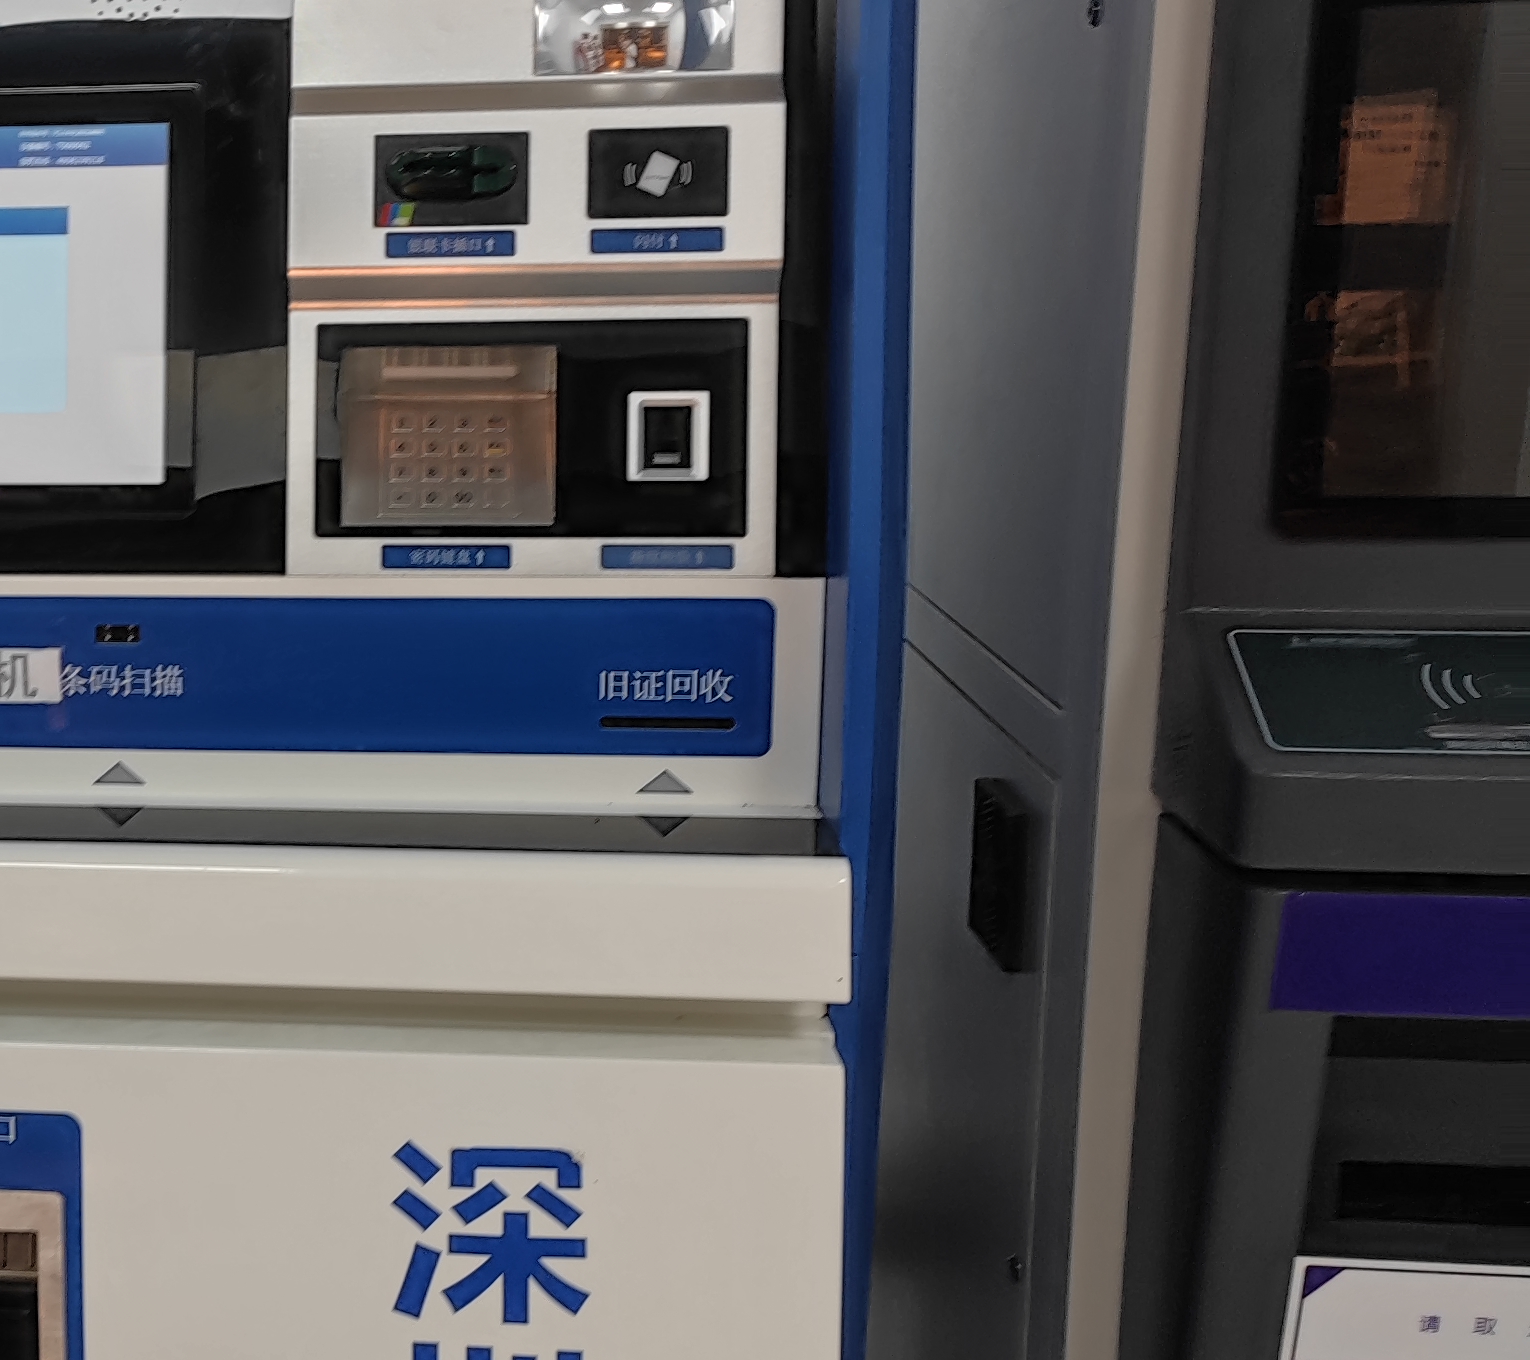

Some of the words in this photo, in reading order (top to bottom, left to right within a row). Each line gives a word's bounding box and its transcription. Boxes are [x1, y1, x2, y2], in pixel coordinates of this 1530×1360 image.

[59, 663, 184, 699] 条码扫描
[597, 668, 734, 703] 旧证回收
[1418, 1314, 1530, 1338] 请取
